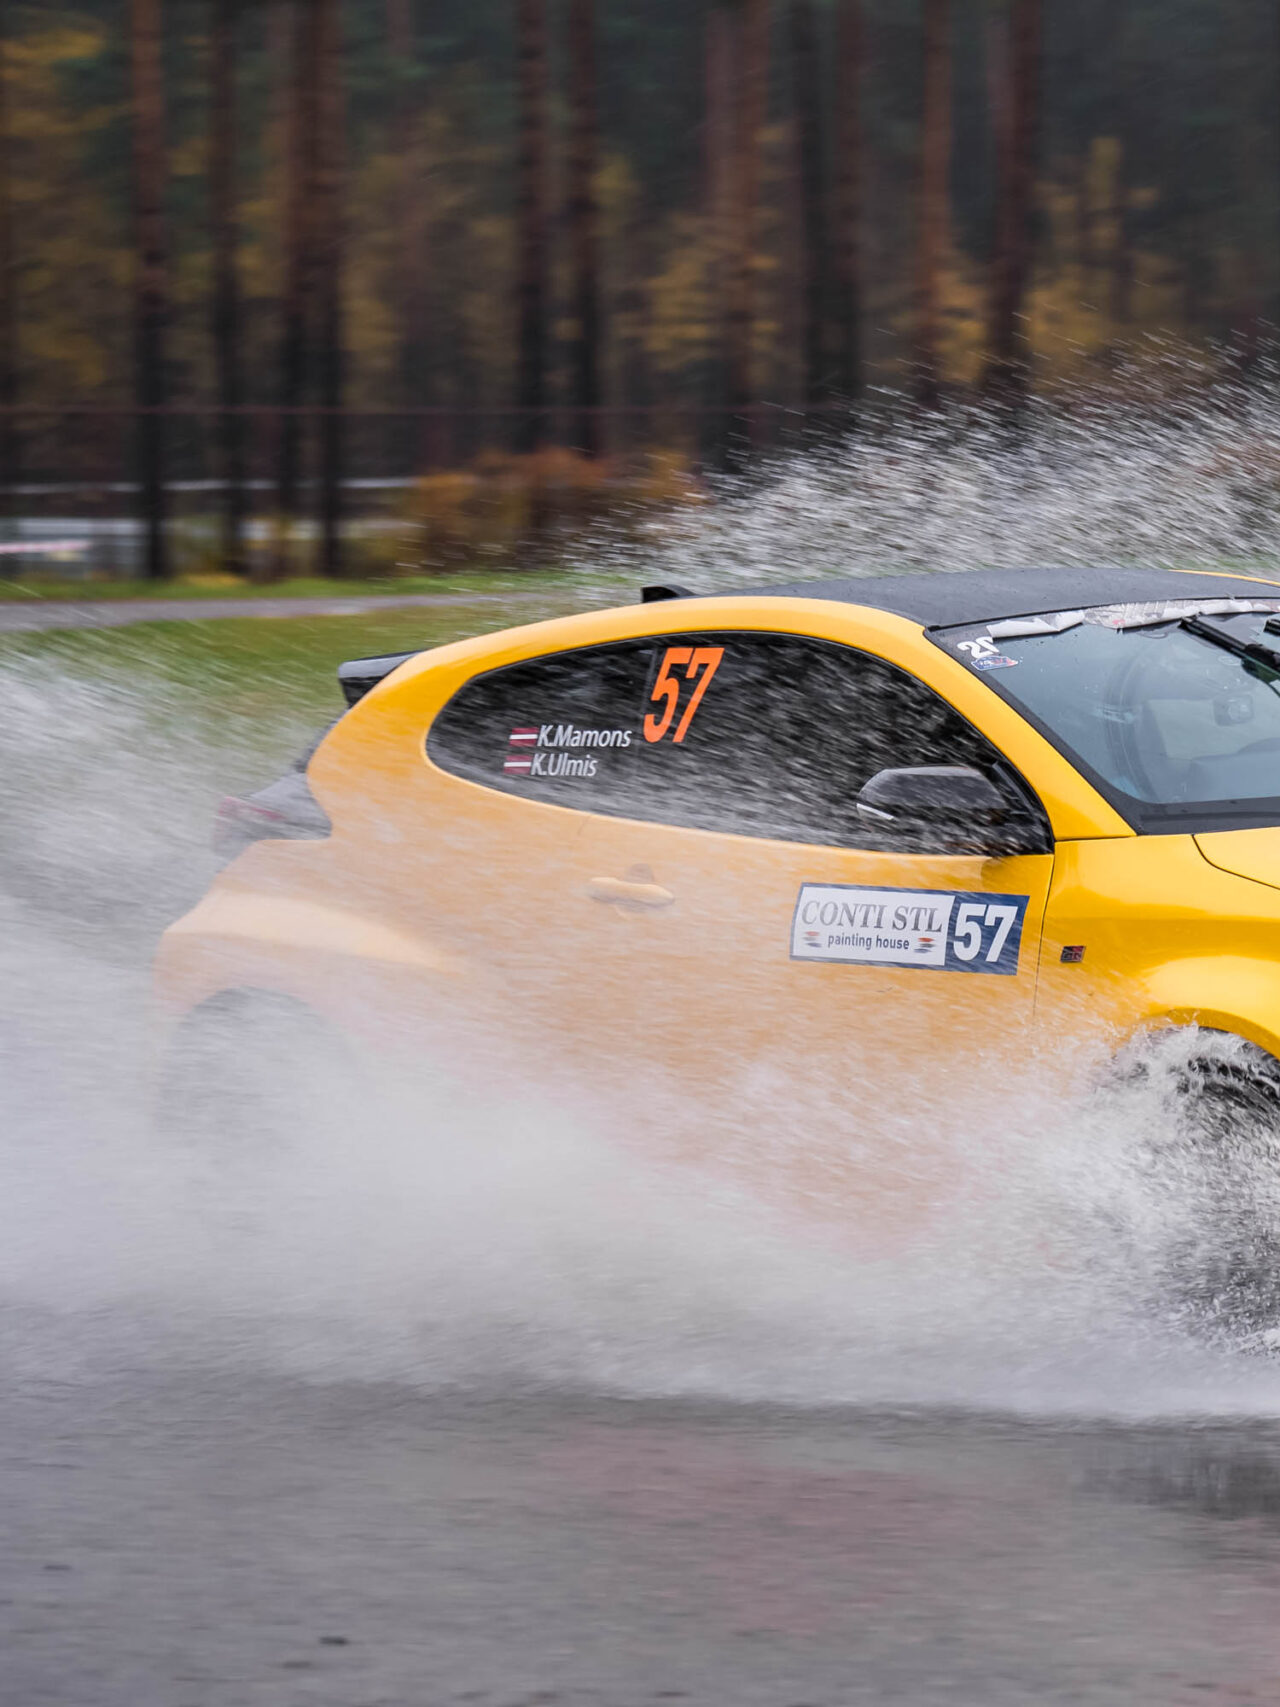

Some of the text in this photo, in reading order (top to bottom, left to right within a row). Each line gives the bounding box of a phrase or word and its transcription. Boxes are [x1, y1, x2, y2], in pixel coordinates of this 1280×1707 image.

[643, 647, 725, 743] 57
[537, 724, 632, 748] K.Mamons
[530, 752, 598, 777] K.Ulmis
[801, 900, 943, 933] CONTI STL
[827, 932, 910, 950] painting house
[952, 903, 1018, 962] 57
